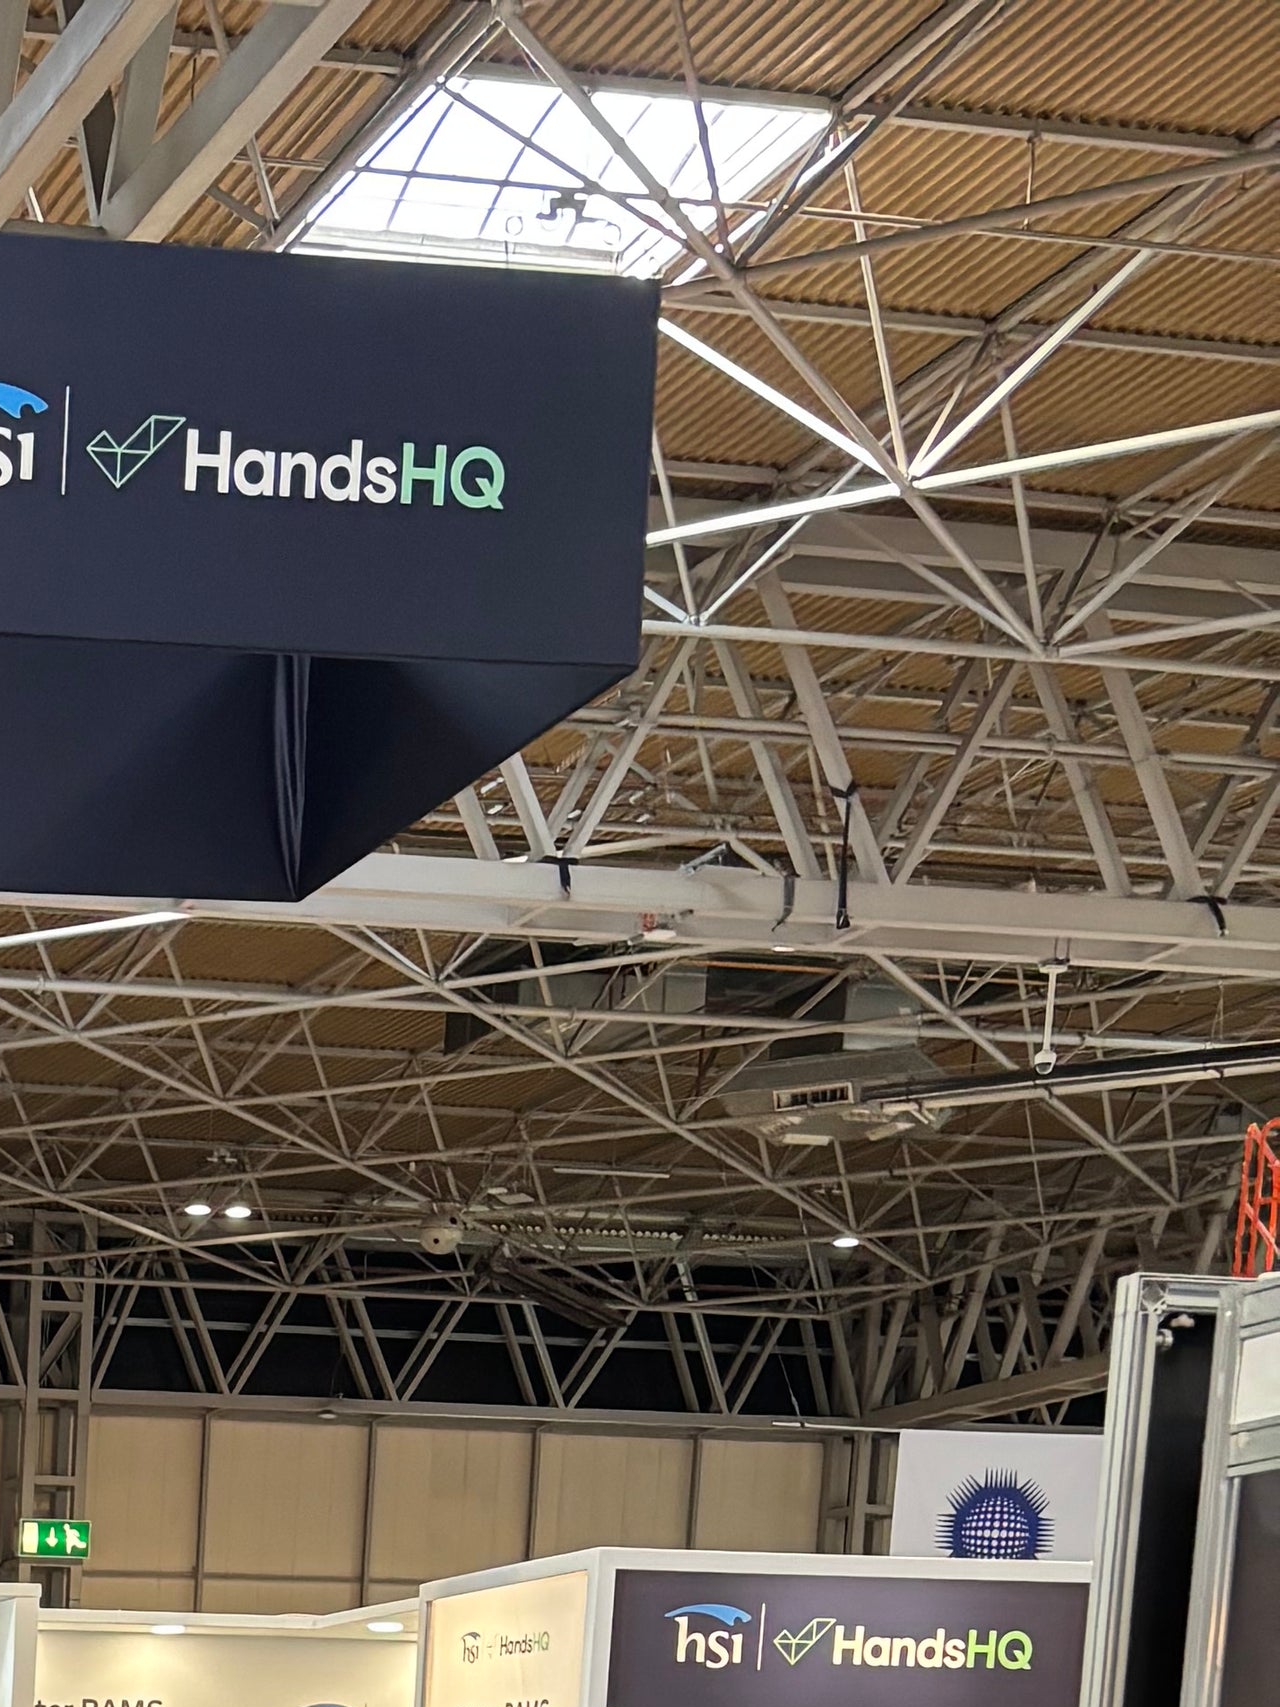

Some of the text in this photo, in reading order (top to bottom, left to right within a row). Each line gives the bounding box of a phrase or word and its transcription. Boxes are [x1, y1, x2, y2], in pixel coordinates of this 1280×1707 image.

[183, 429, 505, 512] HandsHQ
[499, 1631, 550, 1656] HandsHQ
[674, 1615, 1033, 1671] hsi HandsHQ
